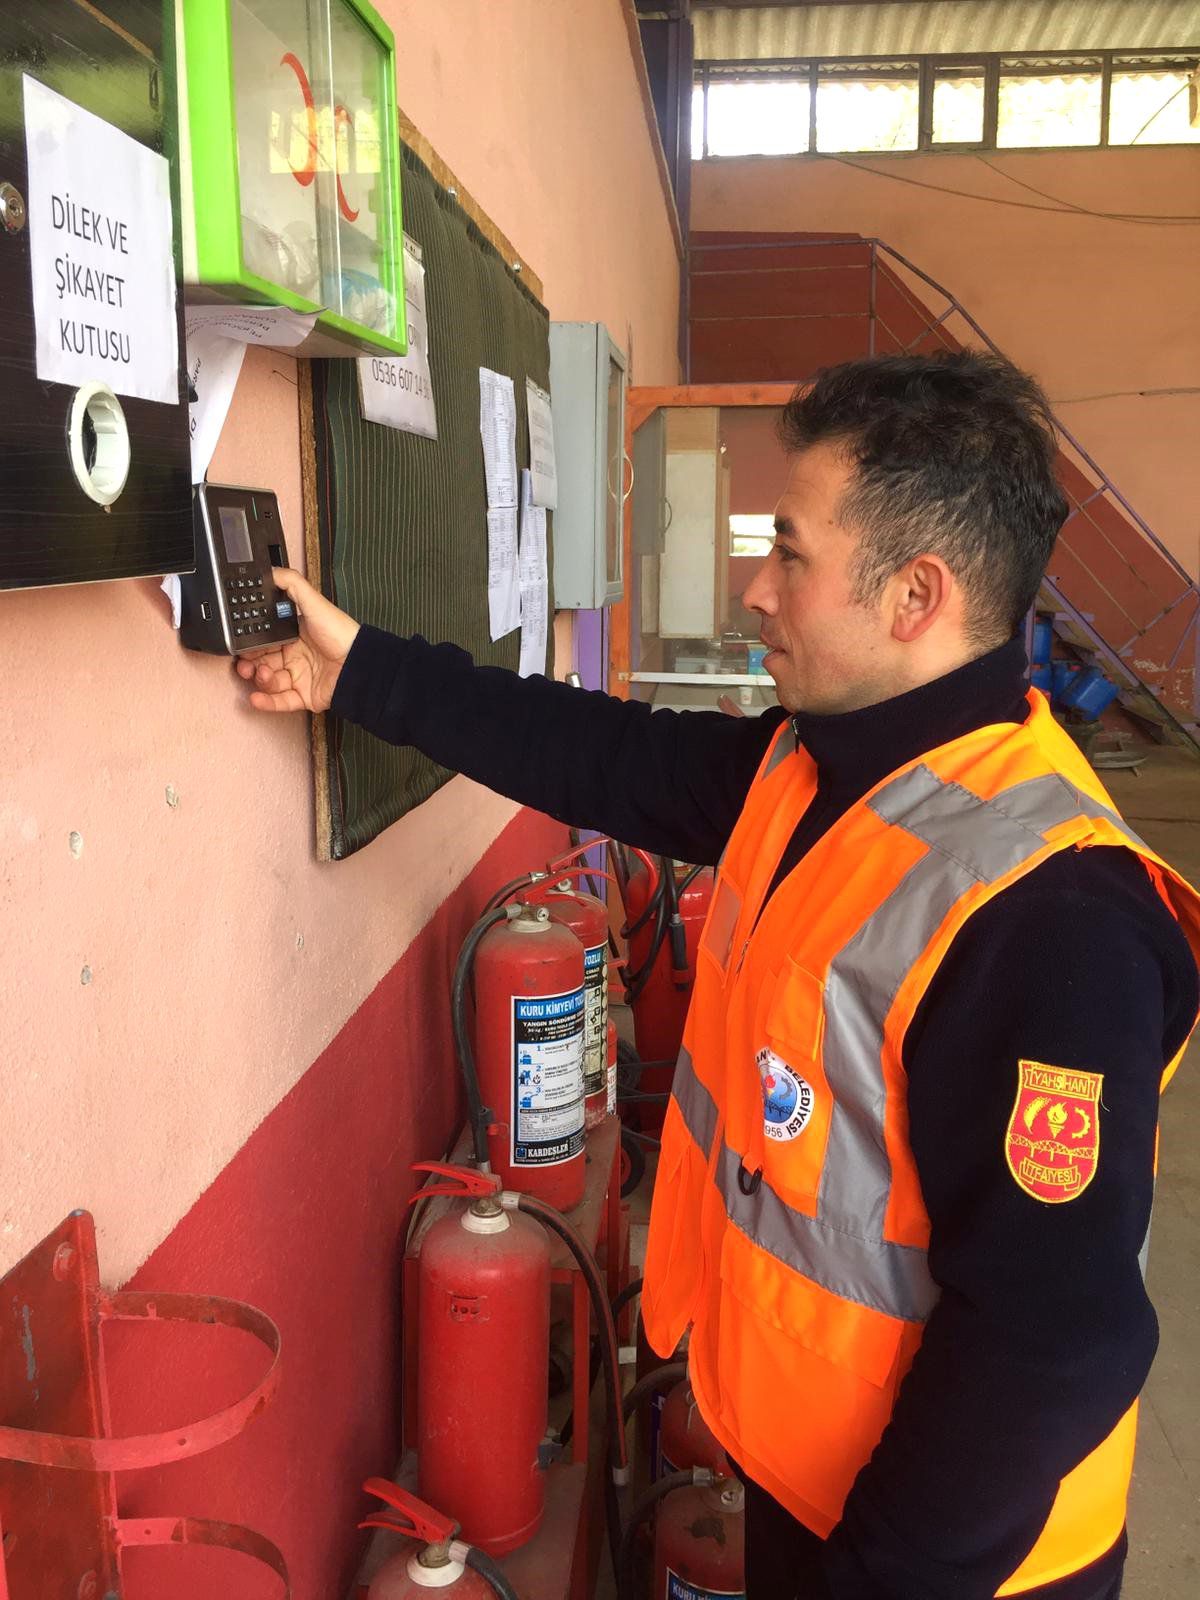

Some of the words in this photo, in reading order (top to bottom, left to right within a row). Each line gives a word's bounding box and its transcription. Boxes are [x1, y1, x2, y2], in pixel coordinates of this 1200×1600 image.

[51, 192, 103, 246] DİLEK
[106, 216, 129, 255] VE
[55, 252, 125, 308] ŞİKAYET
[59, 318, 131, 364] KUTUSU
[371, 358, 397, 387] 0536
[399, 367, 413, 393] 607
[520, 1005, 544, 1017] KURU
